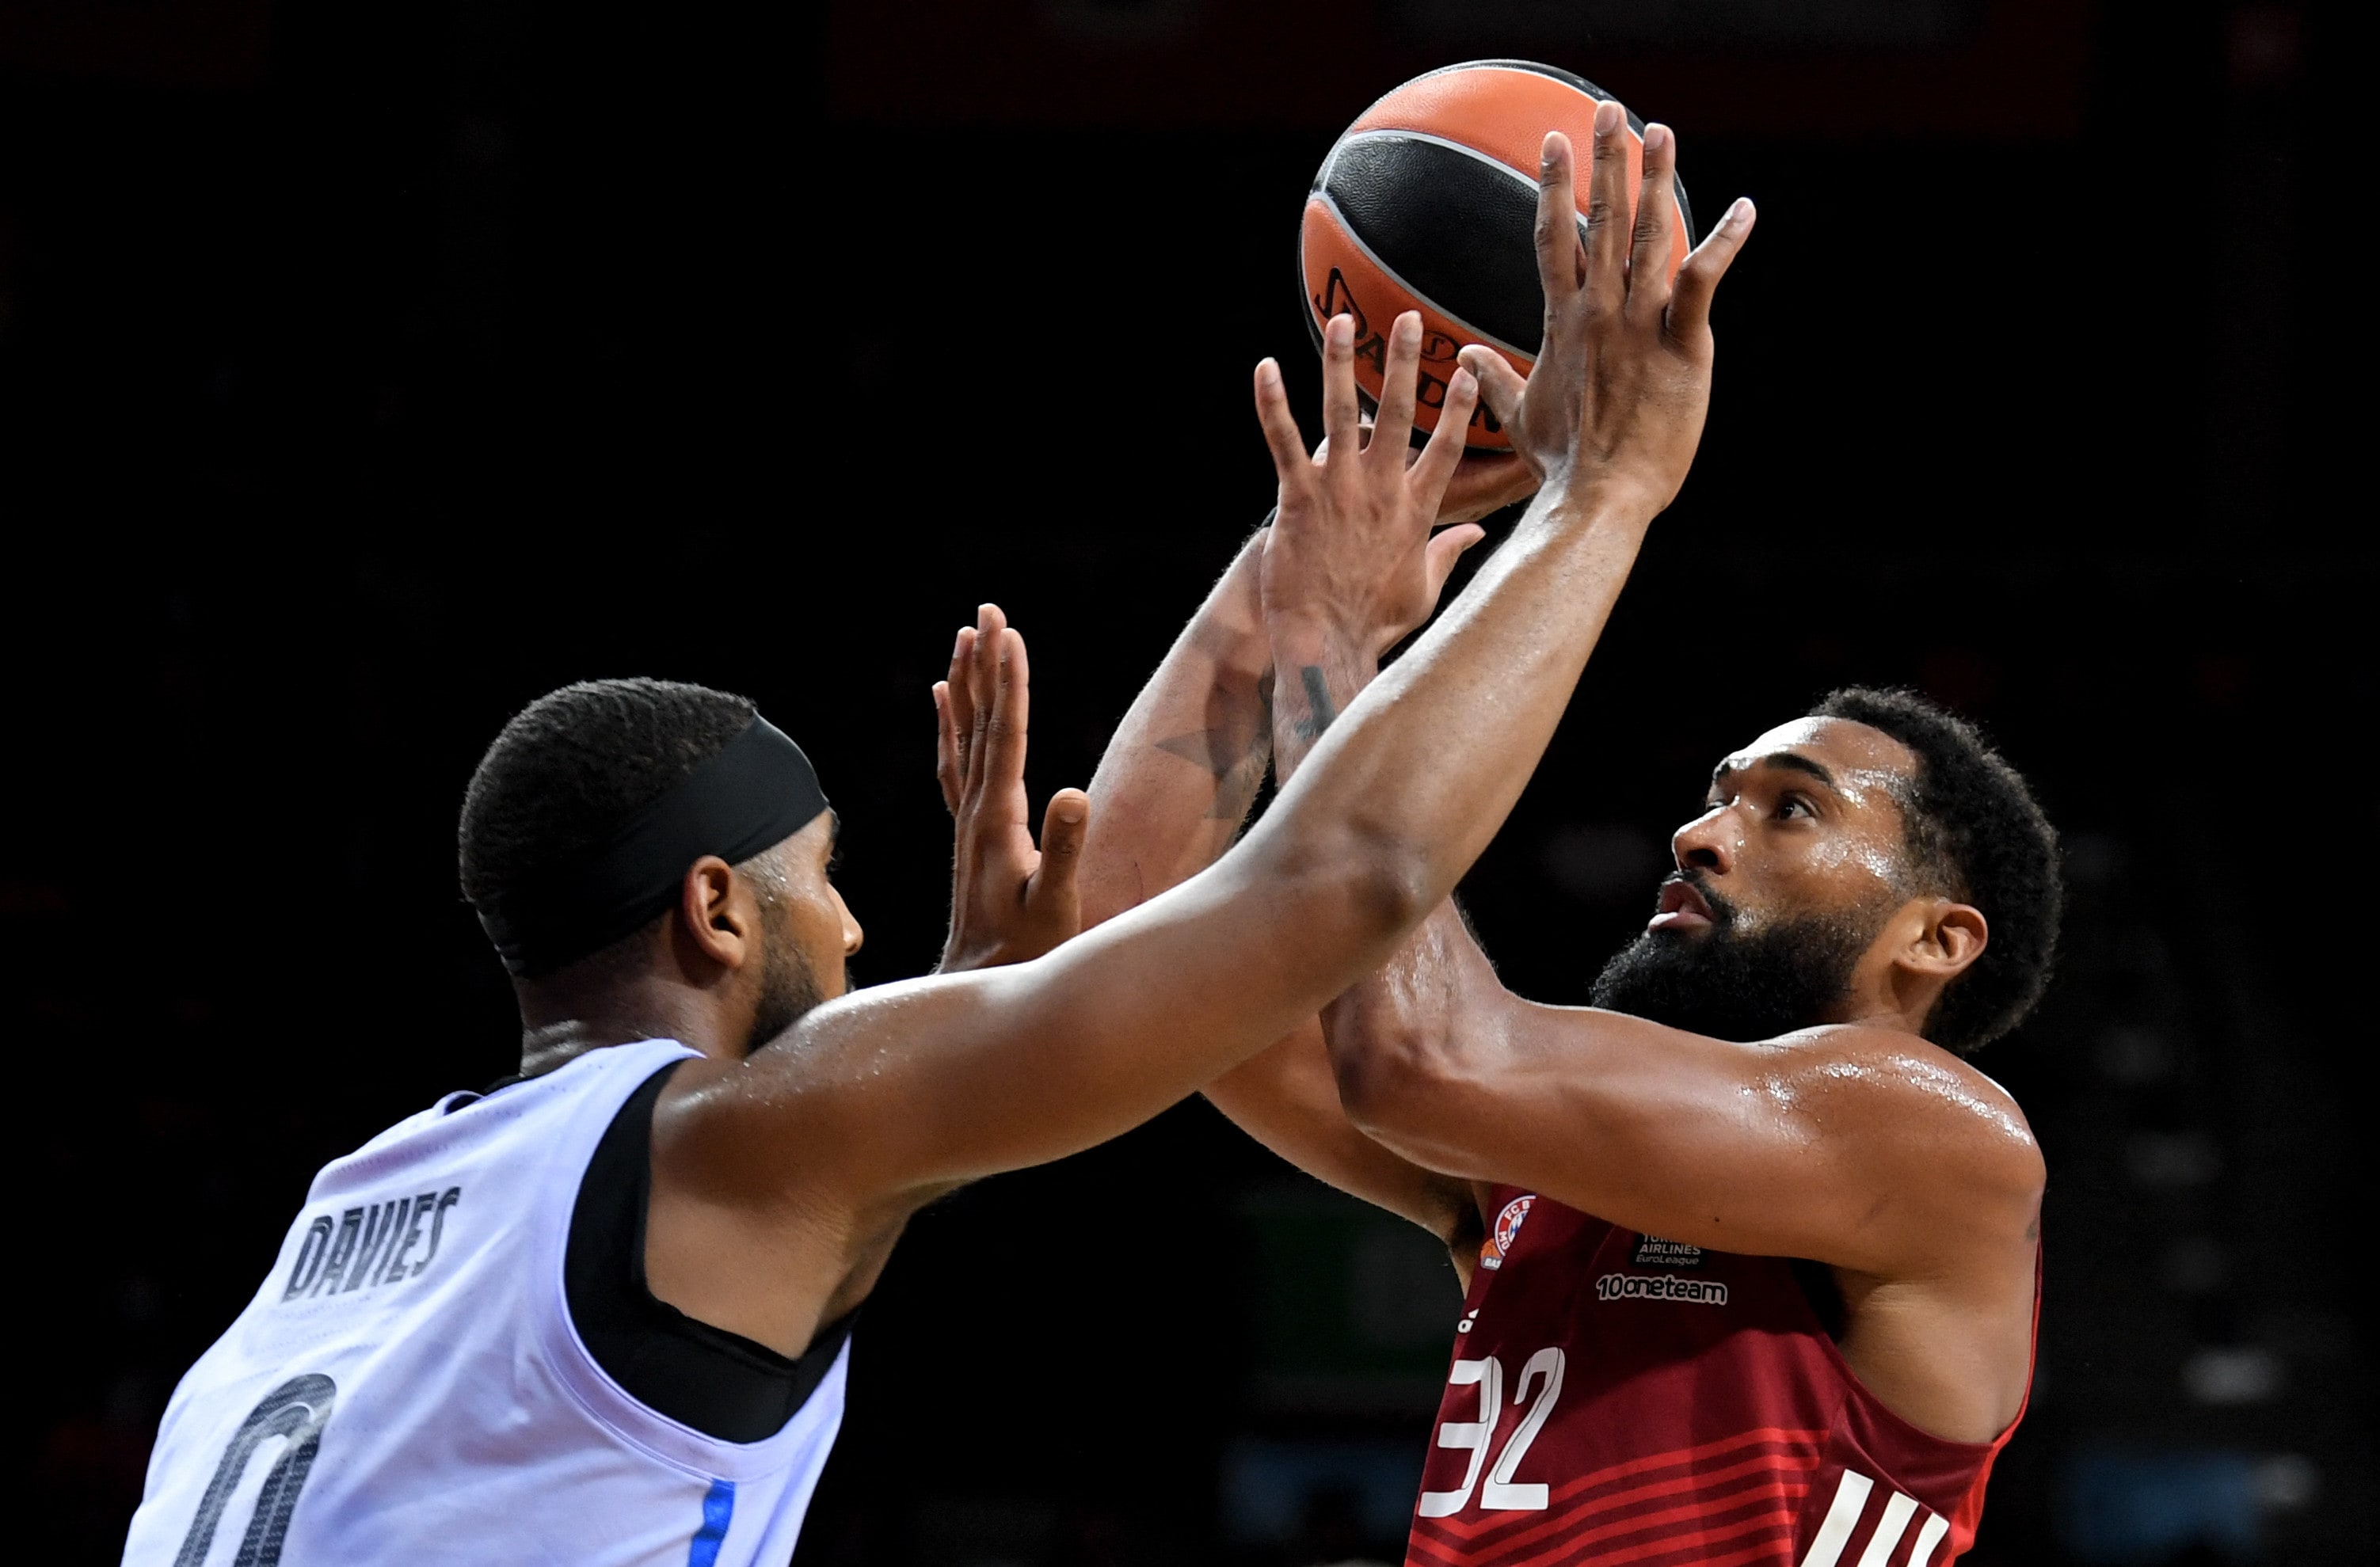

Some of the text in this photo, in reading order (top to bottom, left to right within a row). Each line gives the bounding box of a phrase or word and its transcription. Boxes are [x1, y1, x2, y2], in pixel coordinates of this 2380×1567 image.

[280, 1186, 461, 1303] DAVIES
[1636, 1254, 1700, 1266] EuroLeague
[1639, 1244, 1701, 1255] AIRLINES
[1596, 1273, 1728, 1306] 10oneteam
[172, 1372, 337, 1567] 0
[1418, 1346, 1566, 1518] 32
